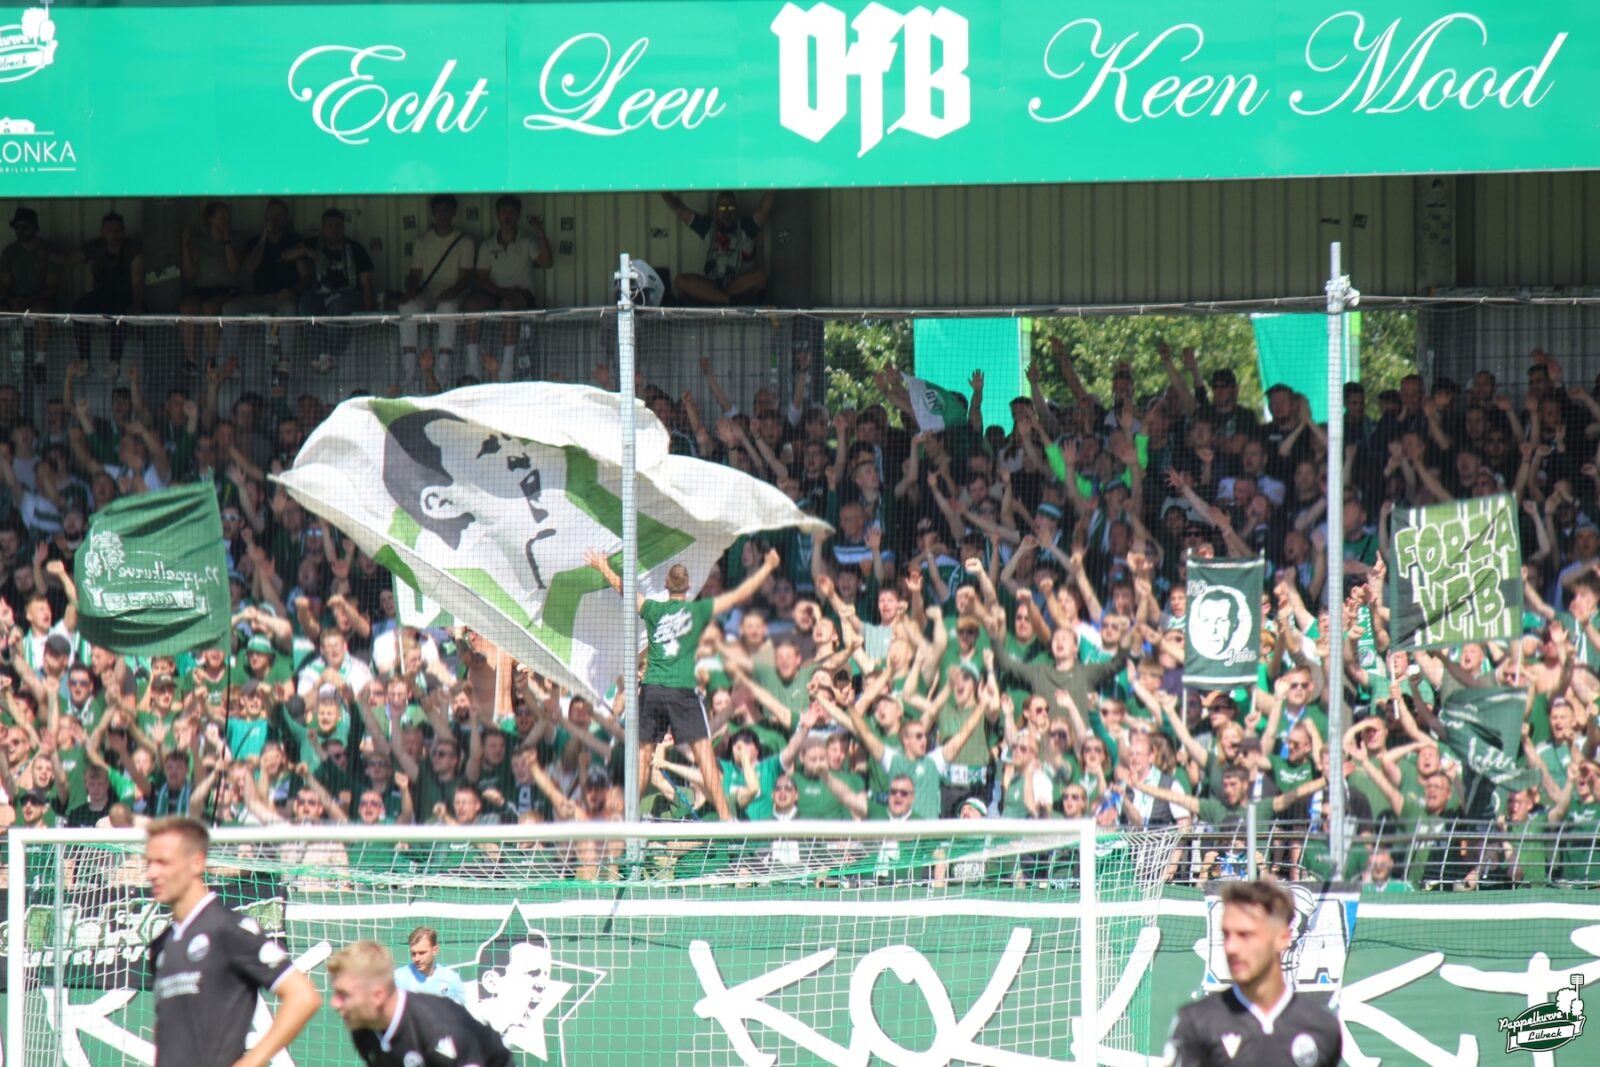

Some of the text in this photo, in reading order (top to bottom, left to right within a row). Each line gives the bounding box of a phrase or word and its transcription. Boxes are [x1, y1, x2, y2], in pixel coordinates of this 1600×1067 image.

[288, 2, 1569, 158] Echt Leev VfB Keen Mood
[0, 140, 77, 164] ONKA
[1394, 504, 1518, 579] FORZA
